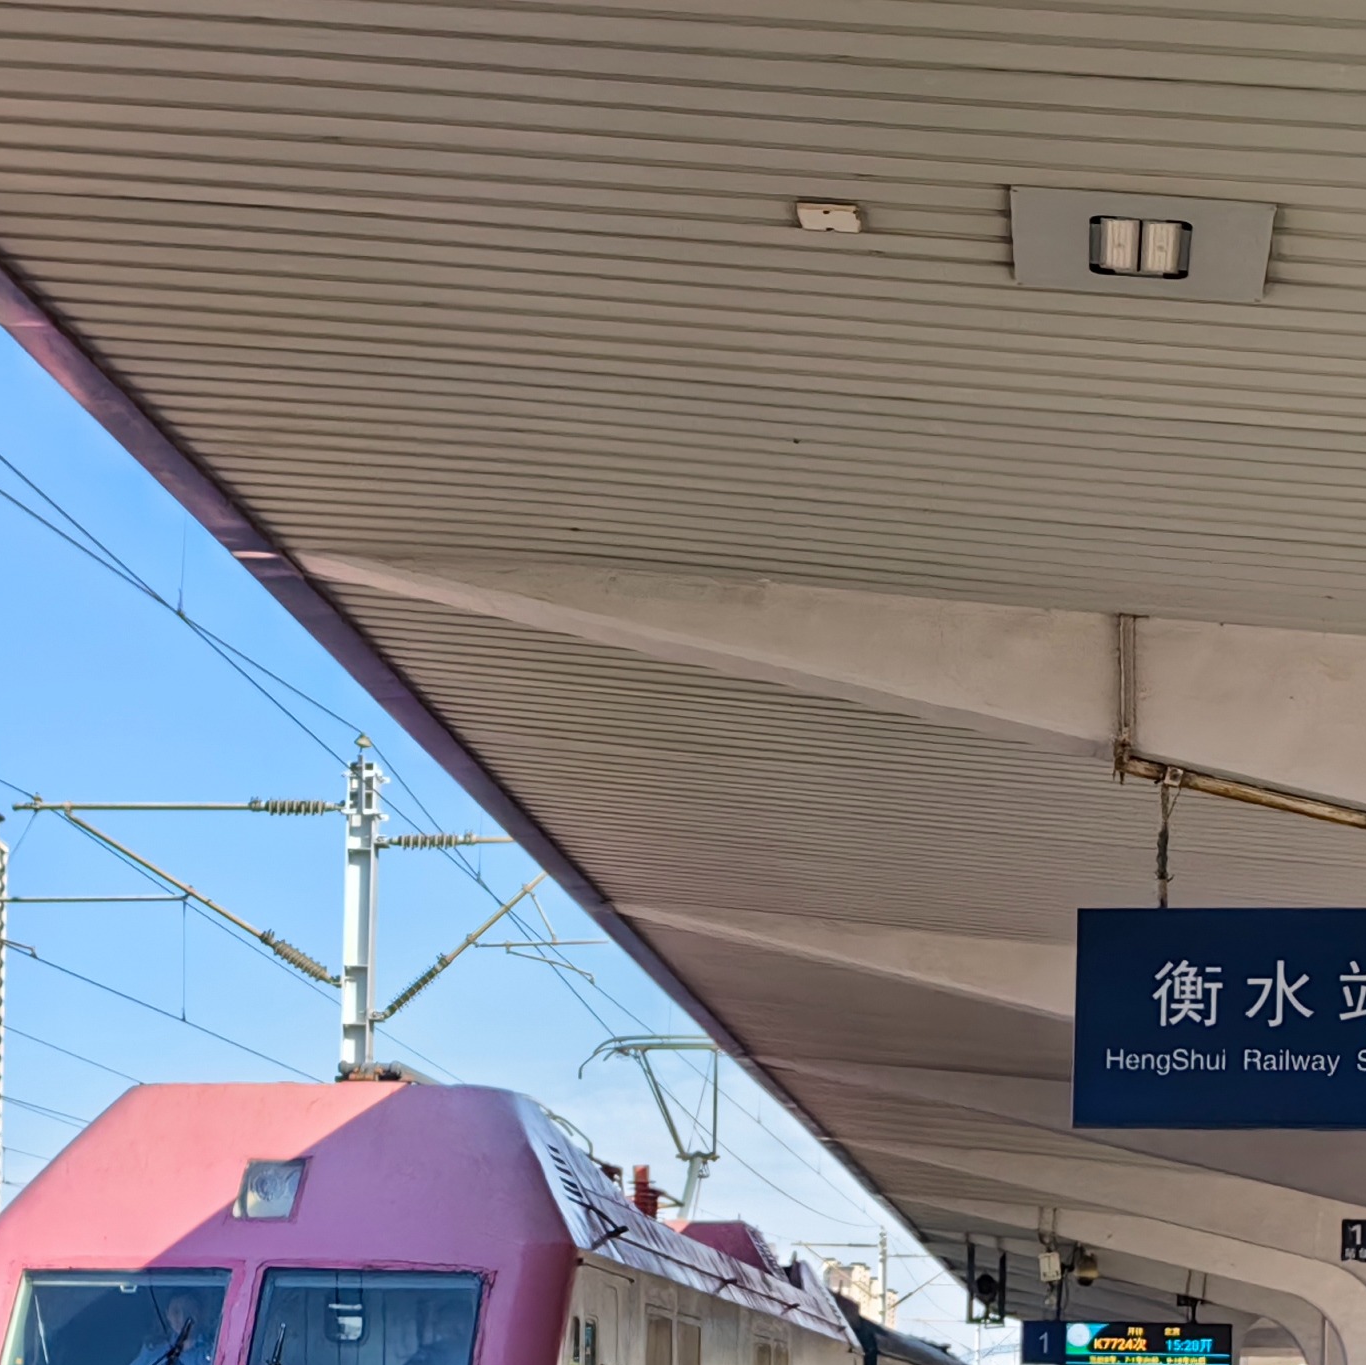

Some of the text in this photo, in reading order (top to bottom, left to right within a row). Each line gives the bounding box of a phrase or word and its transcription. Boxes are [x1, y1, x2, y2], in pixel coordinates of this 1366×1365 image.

[1106, 1048, 1226, 1075] HengShui
[1243, 1048, 1340, 1076] Railway
[1350, 1224, 1362, 1245] 1
[1039, 1332, 1049, 1354] 1
